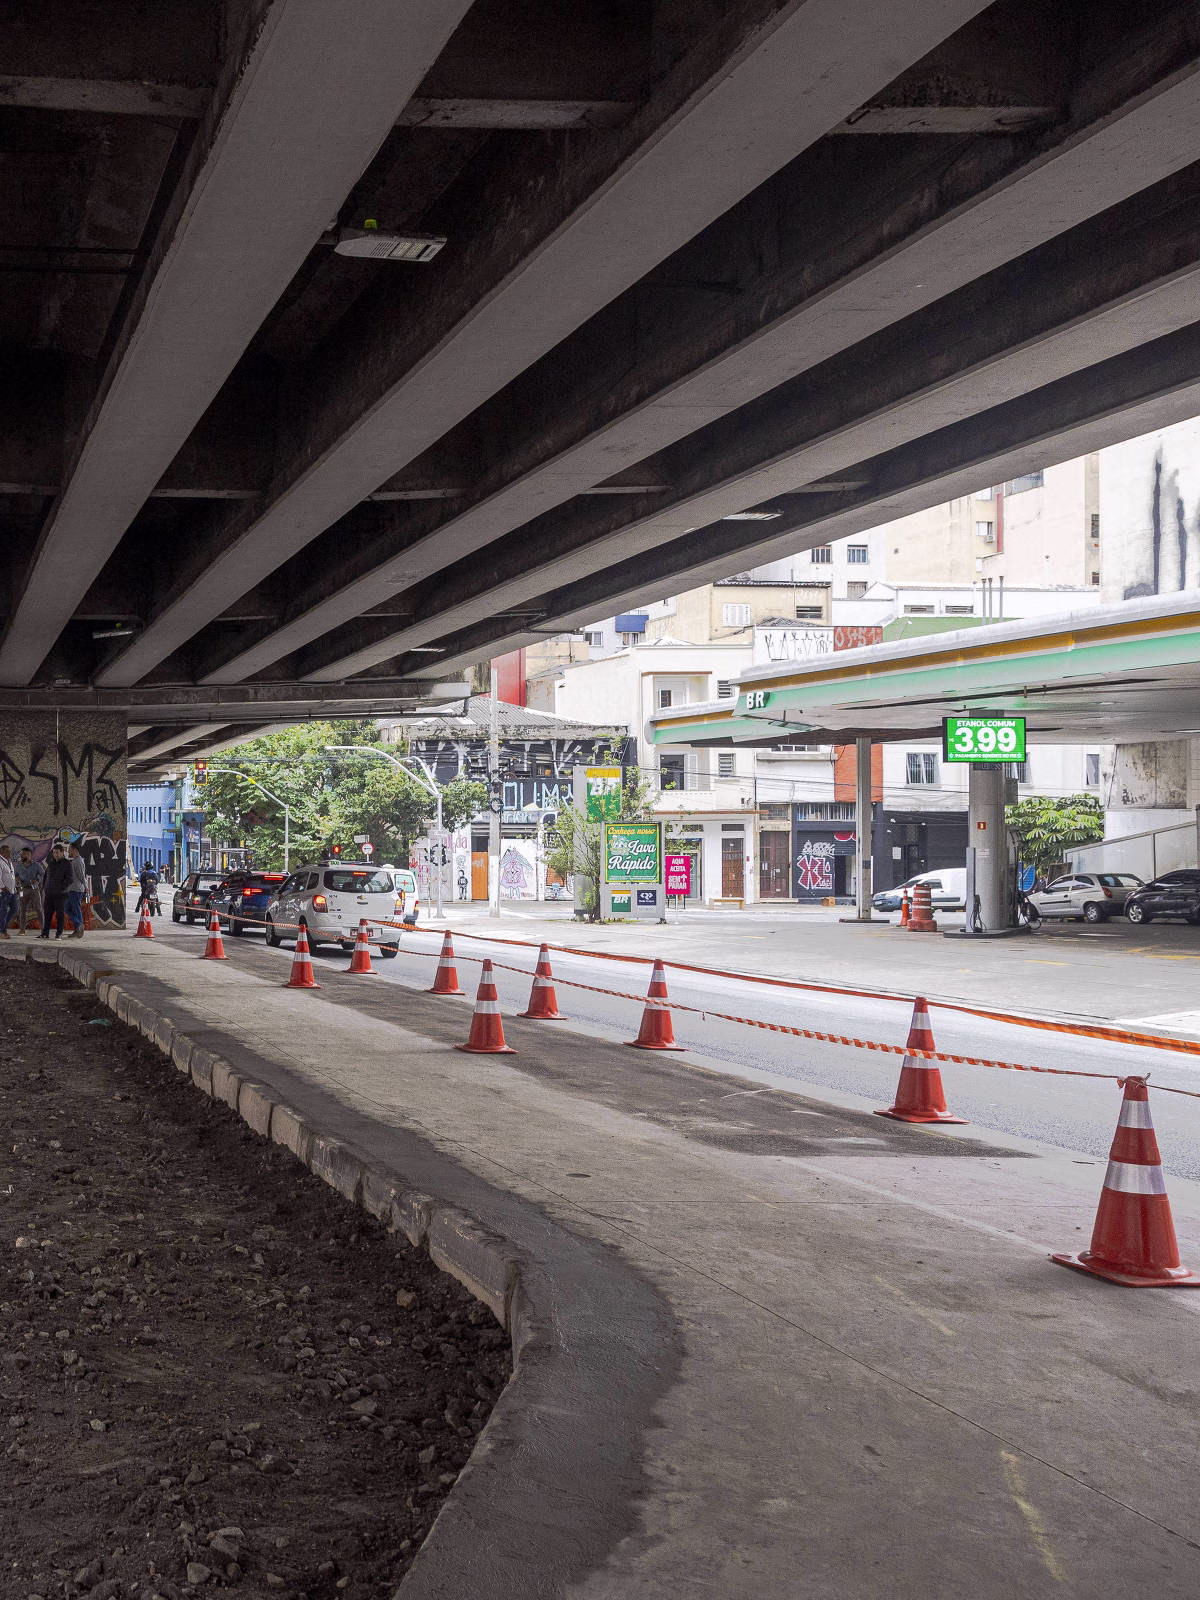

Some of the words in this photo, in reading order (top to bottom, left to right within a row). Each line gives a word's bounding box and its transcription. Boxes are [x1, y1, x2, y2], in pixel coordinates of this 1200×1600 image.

[746, 691, 766, 710] BR
[954, 727, 1017, 753] 3,99
[628, 840, 656, 855] Lava
[608, 855, 656, 875] Rápido
[668, 882, 687, 890] PARAR
[613, 895, 629, 904] BR
